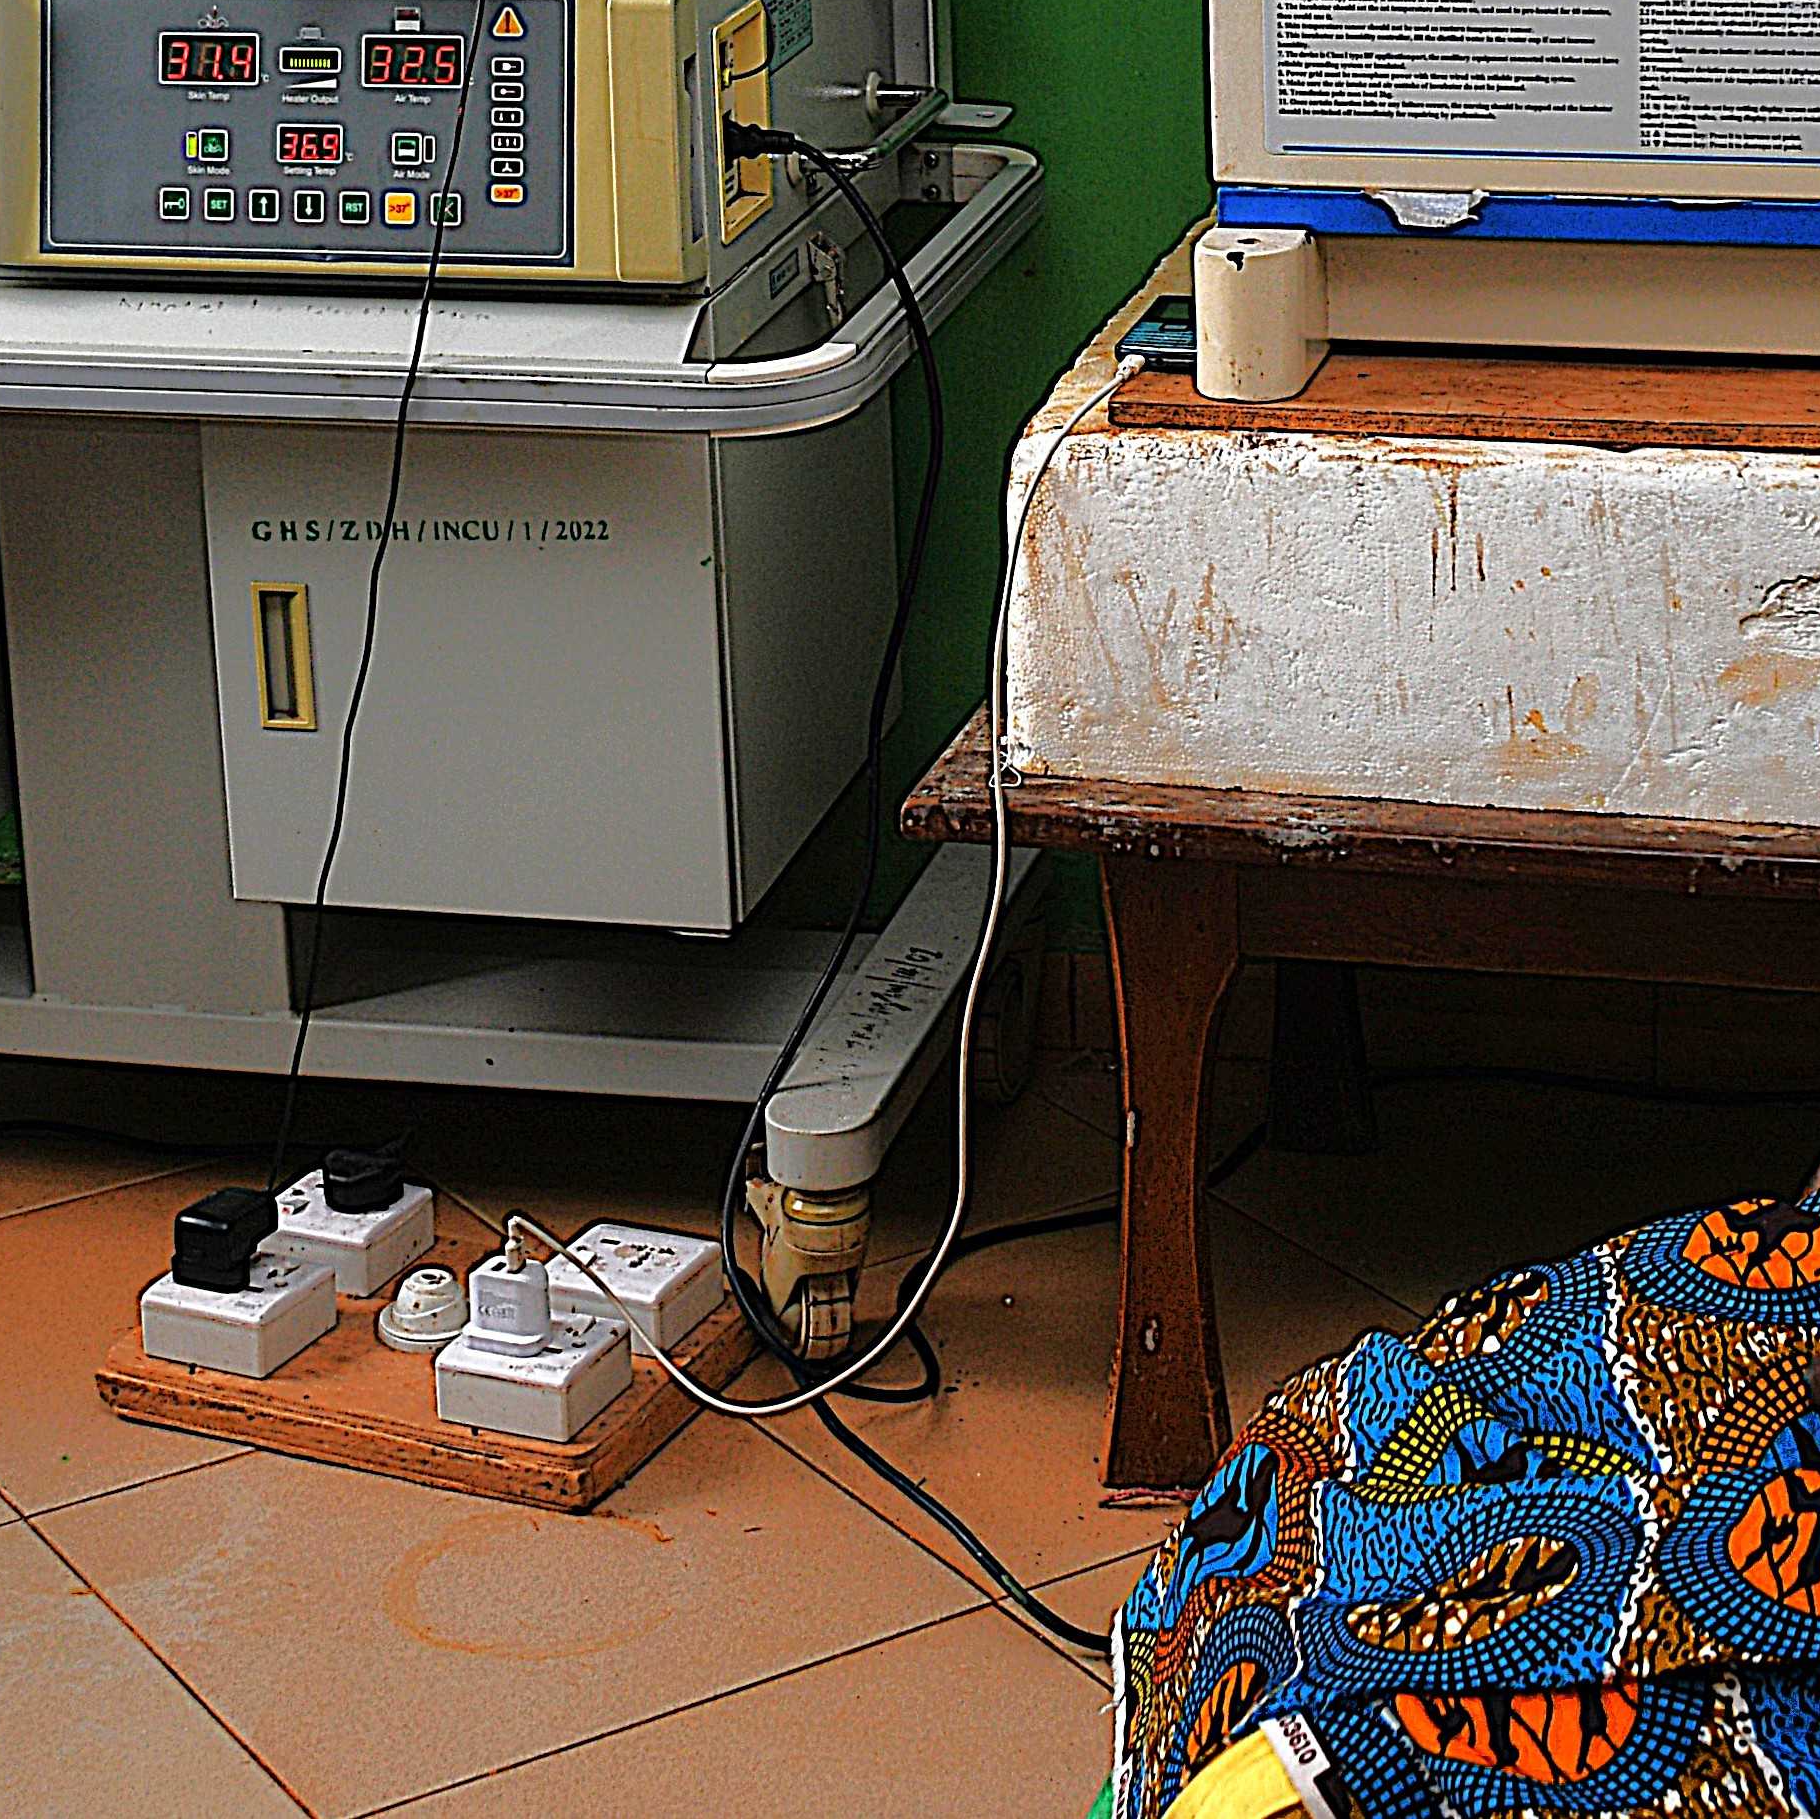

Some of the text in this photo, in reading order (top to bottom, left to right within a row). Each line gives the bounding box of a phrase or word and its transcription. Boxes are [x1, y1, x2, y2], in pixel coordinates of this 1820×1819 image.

[370, 44, 456, 83] 32.5
[186, 91, 230, 101] Skin Temp
[281, 94, 339, 104] Heater Output
[393, 93, 431, 105] Air Temp
[186, 165, 230, 175] Skin Mode
[282, 166, 336, 177] Setting Temp
[392, 169, 430, 179] Air Mode
[209, 199, 228, 210] SET
[344, 202, 364, 213] RST
